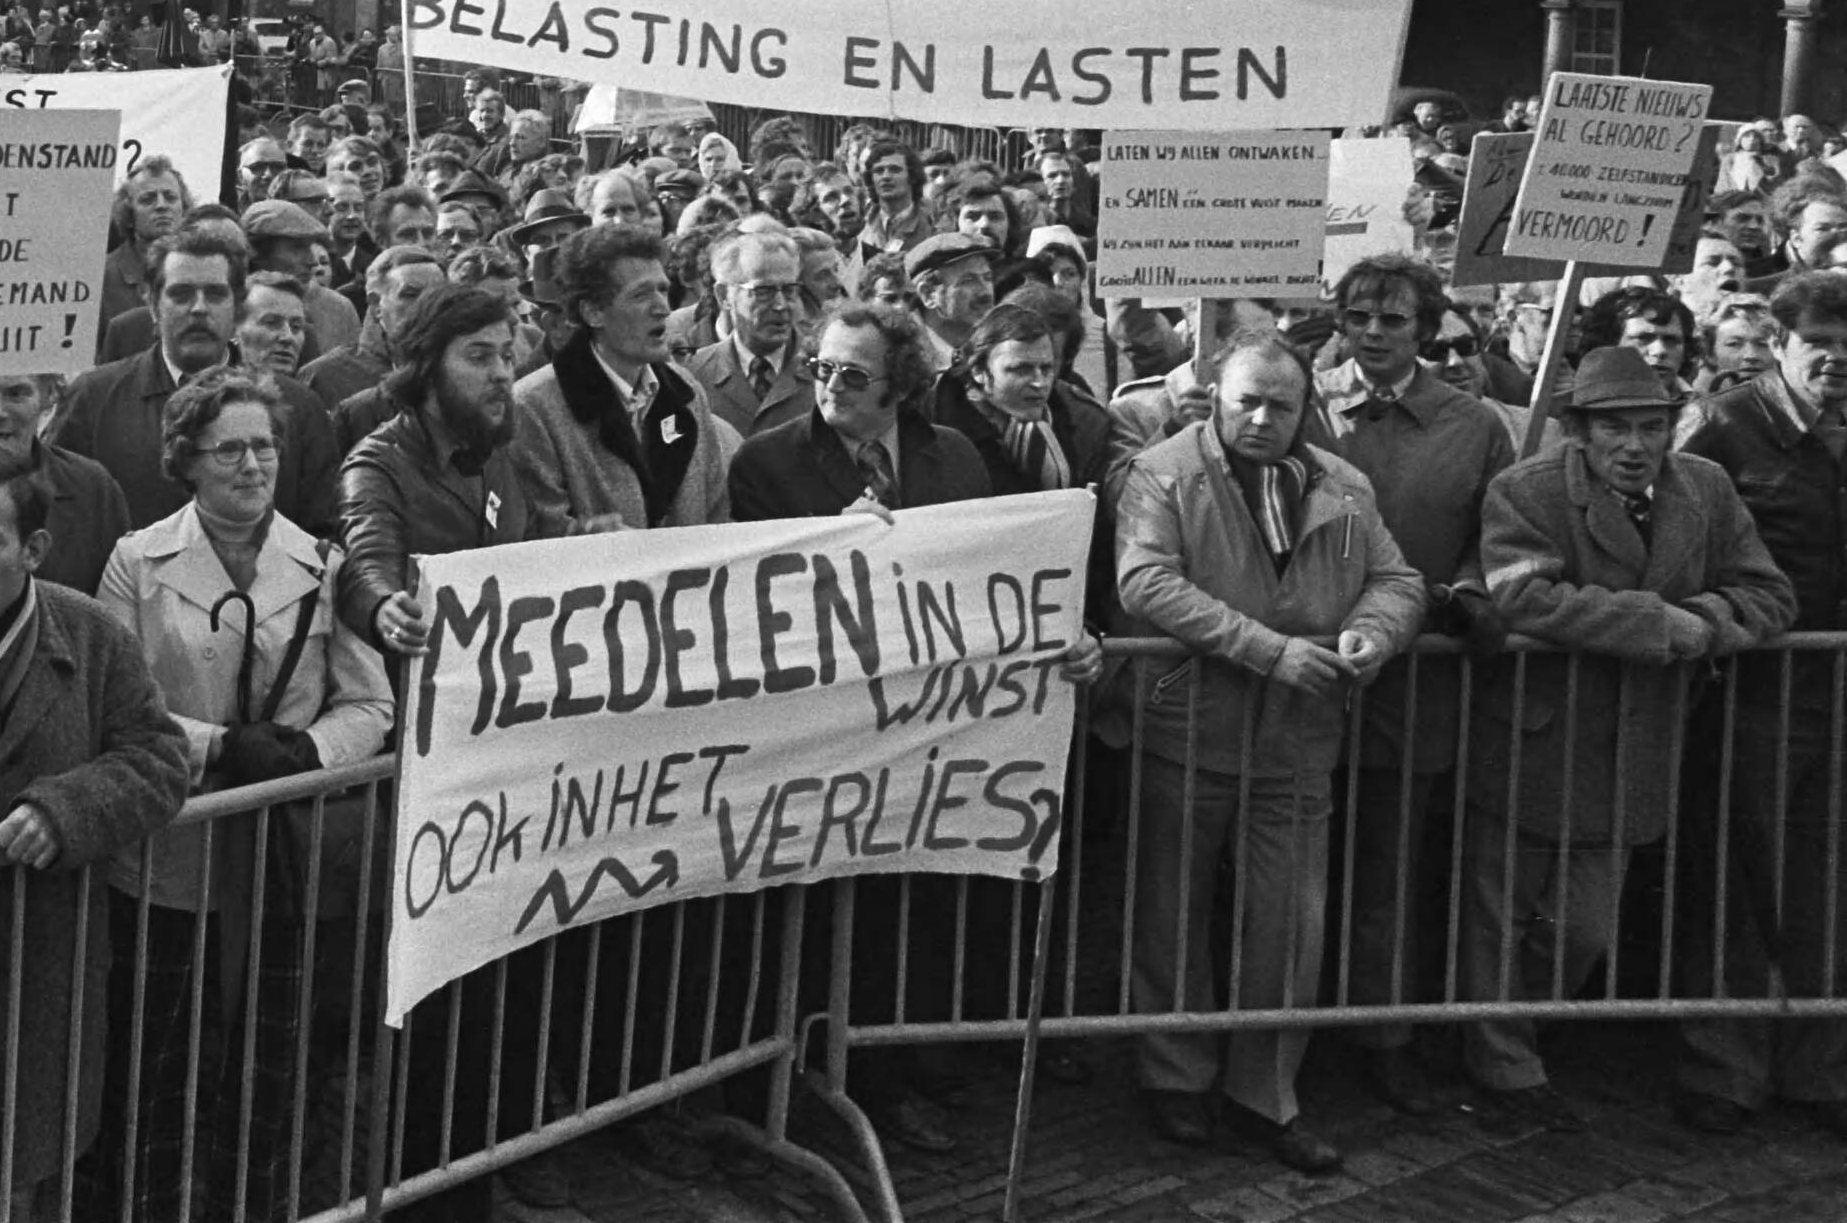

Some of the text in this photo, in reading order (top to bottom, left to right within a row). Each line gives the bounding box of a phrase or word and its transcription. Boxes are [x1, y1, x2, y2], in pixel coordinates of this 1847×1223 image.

[844, 36, 935, 94] EN
[982, 45, 1287, 105] LASTEN
[1556, 82, 1703, 118] LAATSTE NIEUWS
[1544, 118, 1567, 143] AL
[1107, 145, 1149, 161] LATEN
[1180, 146, 1220, 160] ALLEN
[1105, 197, 1120, 208] EN
[1125, 187, 1178, 209] SAMEN
[417, 550, 880, 757] MEEDELEN
[987, 568, 1071, 655] DE
[868, 658, 1068, 731] WINST
